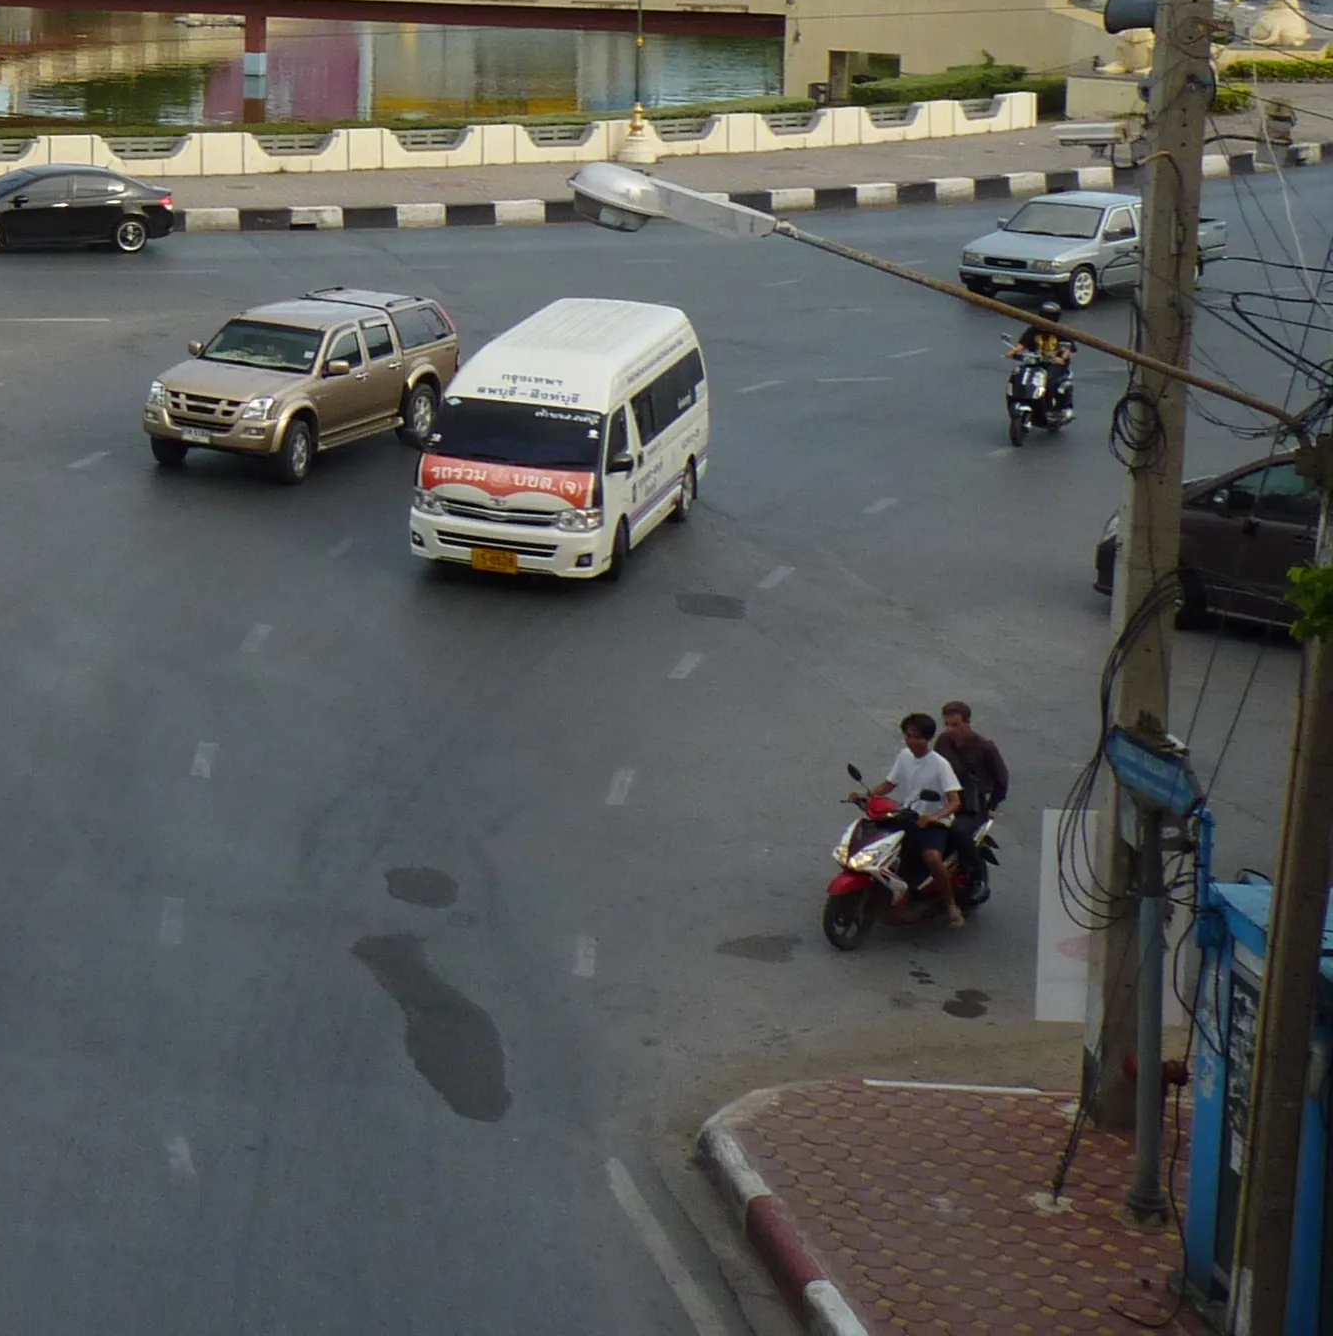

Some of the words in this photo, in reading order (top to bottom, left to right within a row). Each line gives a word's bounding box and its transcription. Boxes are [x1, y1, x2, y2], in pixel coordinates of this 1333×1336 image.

[477, 386, 518, 399] ลพบุรี
[529, 388, 581, 406] สิงห์บุรี
[430, 463, 488, 481] รถร่วม
[512, 473, 558, 492] บขส.
[559, 481, 583, 495] (จ)
